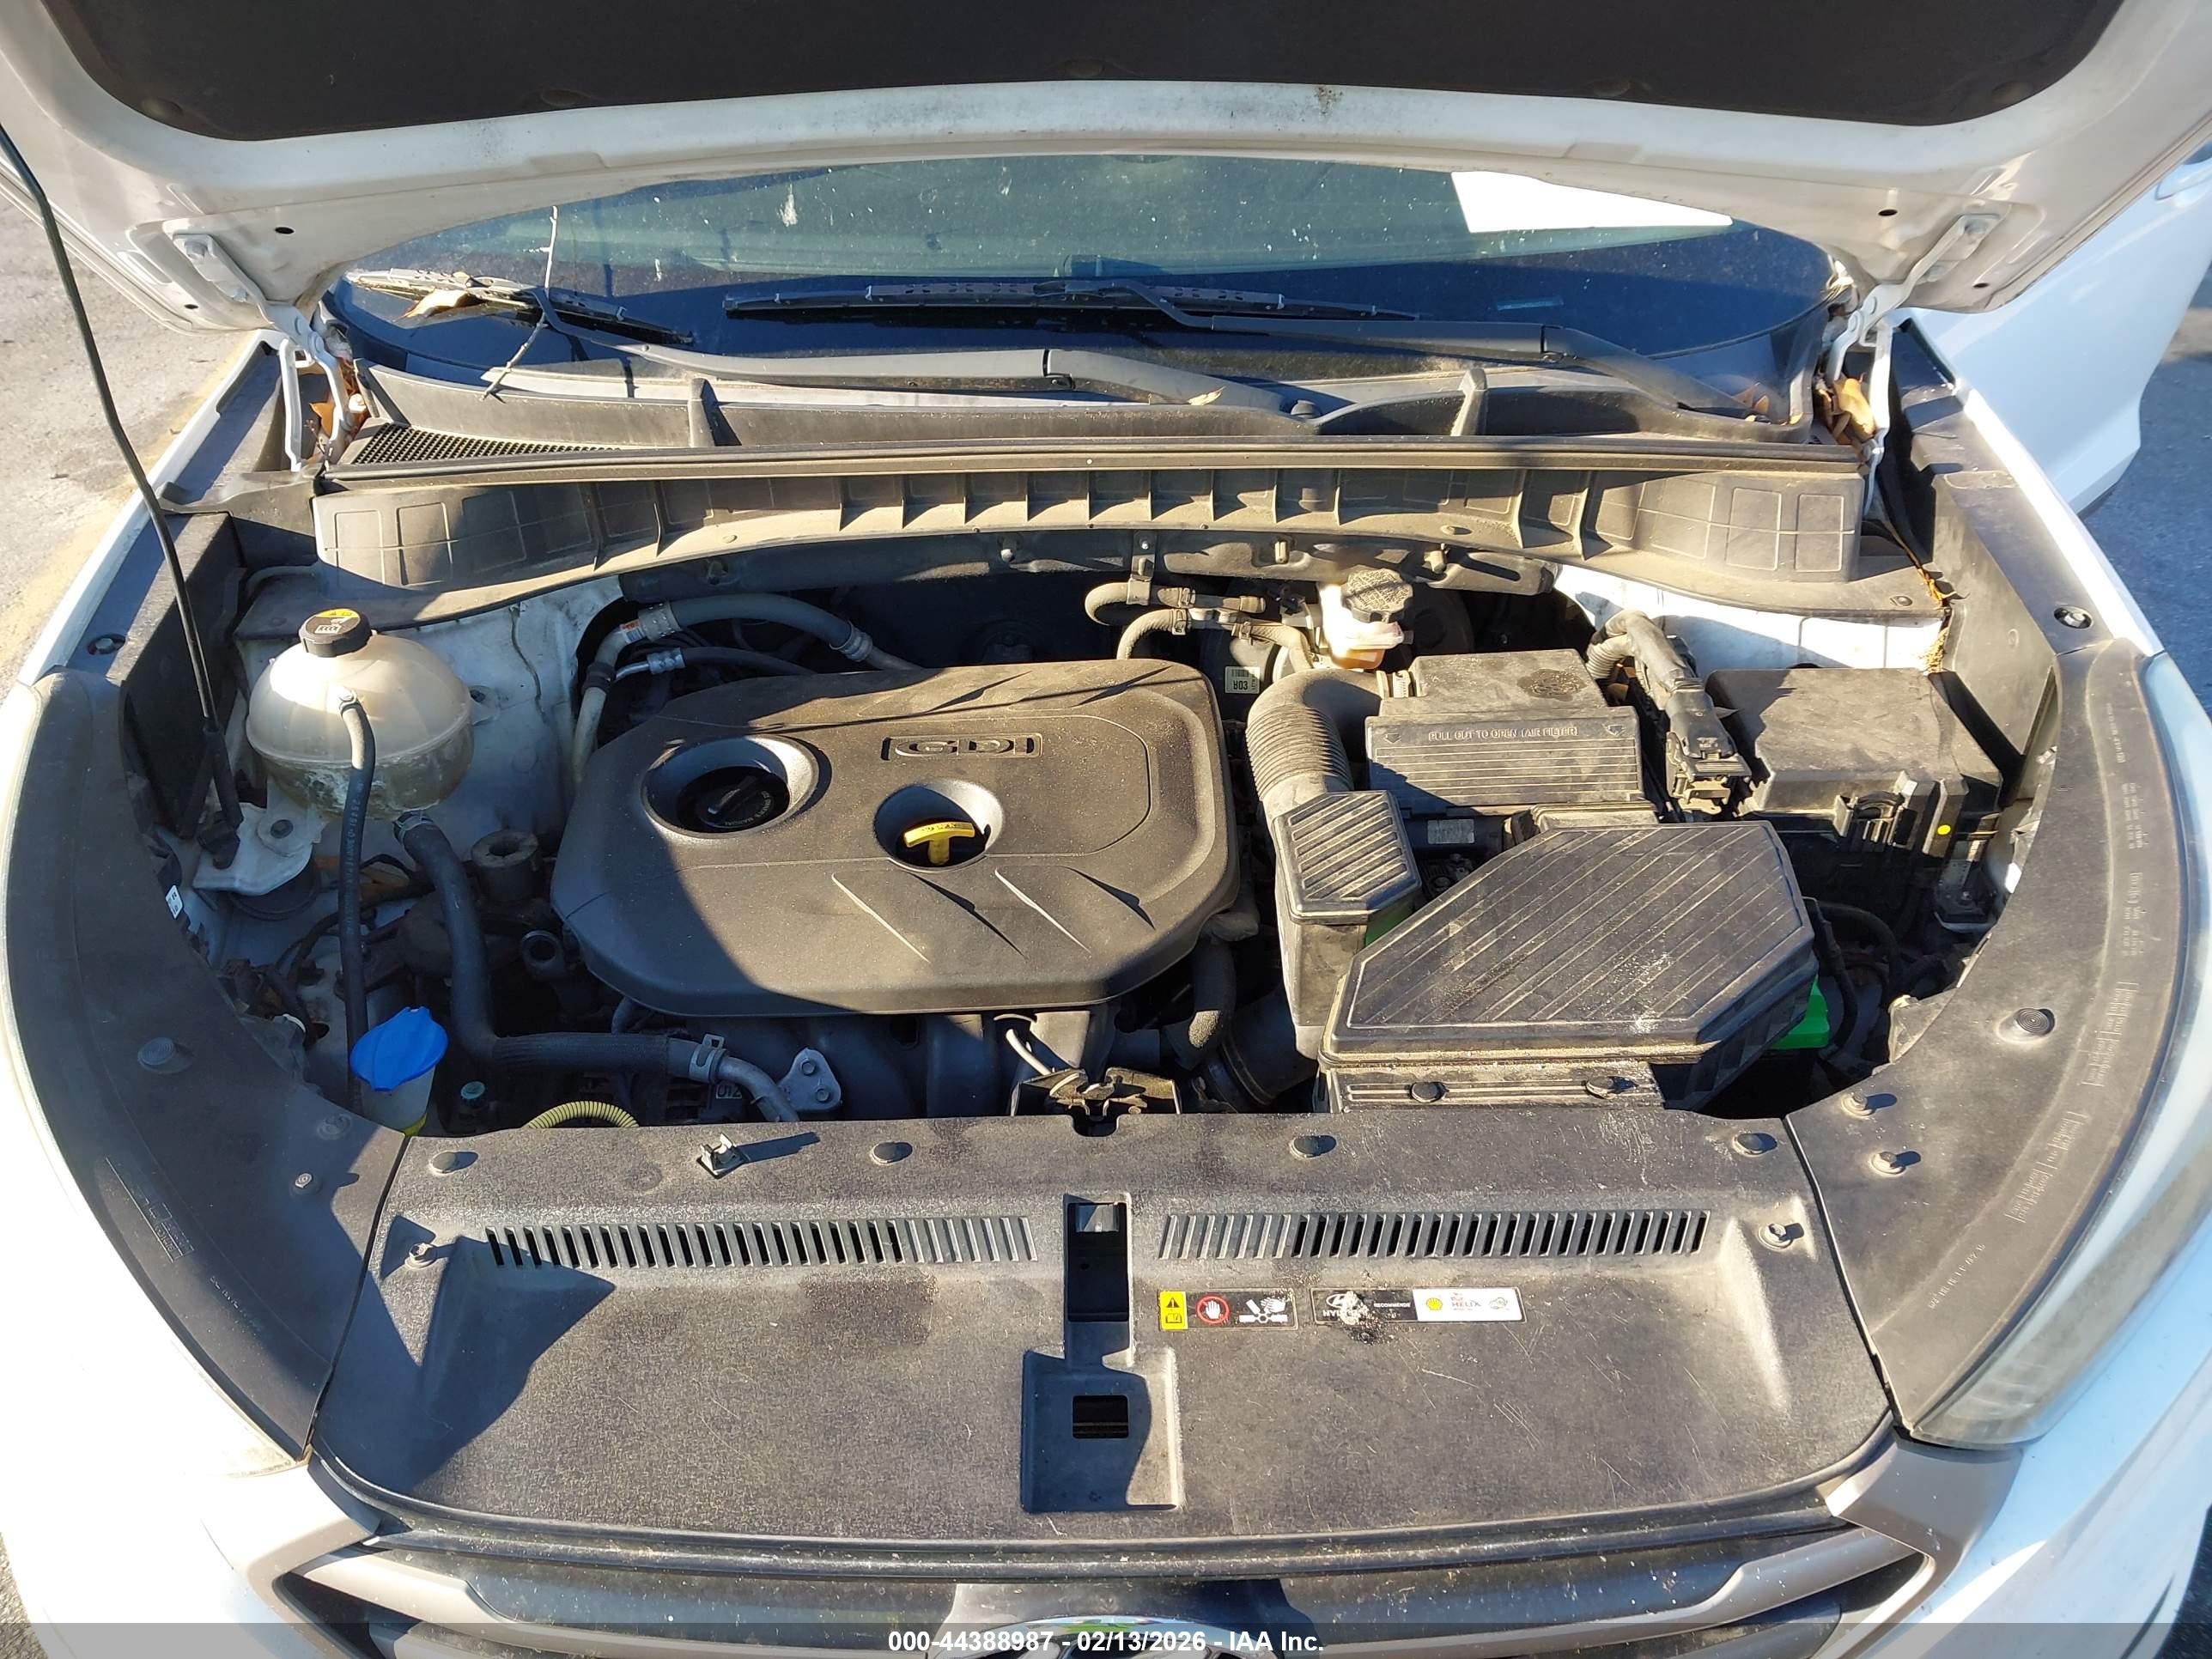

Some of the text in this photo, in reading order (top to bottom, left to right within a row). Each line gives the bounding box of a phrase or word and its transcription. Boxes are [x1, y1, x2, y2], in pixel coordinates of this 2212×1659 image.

[1454, 730, 1474, 740] OUT
[1475, 729, 1489, 739] TO
[1491, 728, 1517, 739] OPEN
[894, 736, 1036, 759] GDI
